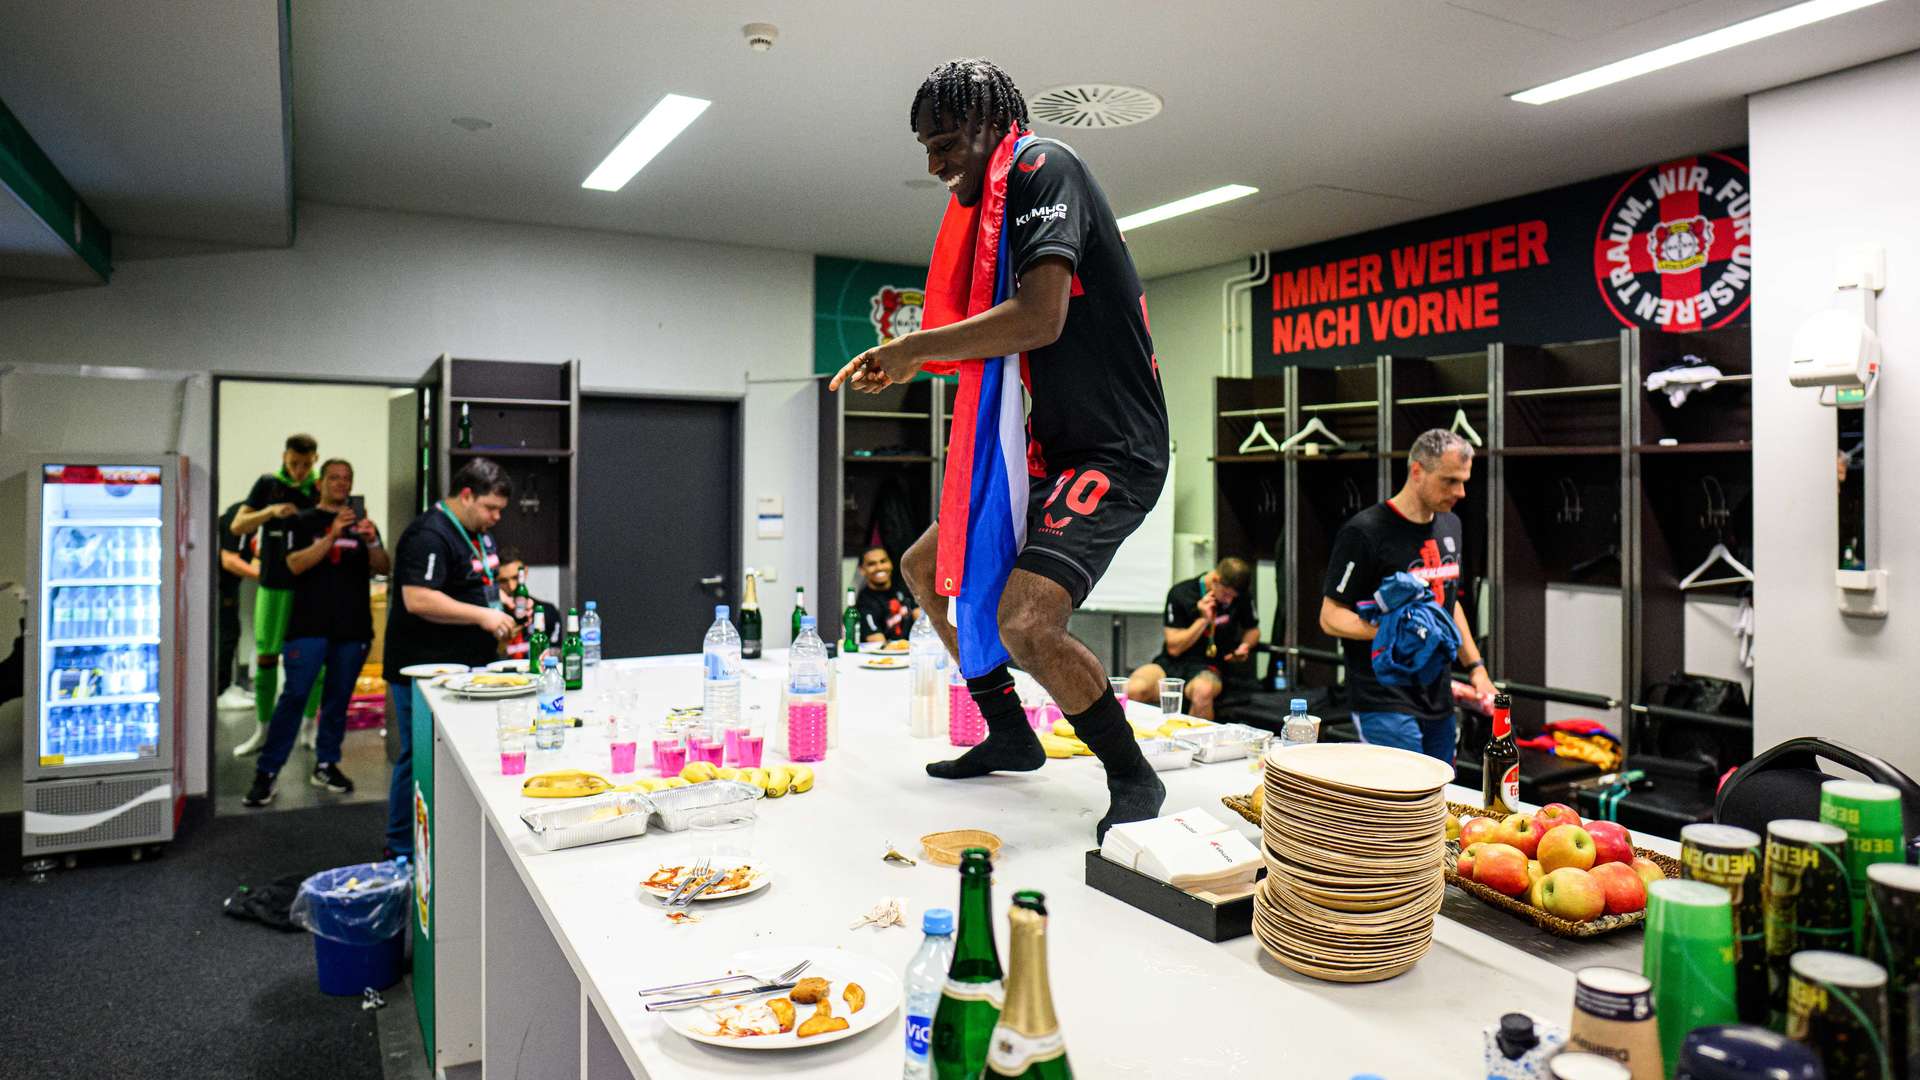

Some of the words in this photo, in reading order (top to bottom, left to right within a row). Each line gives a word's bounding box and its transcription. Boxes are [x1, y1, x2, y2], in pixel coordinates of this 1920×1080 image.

[1649, 166, 1713, 200] WIR.
[1272, 254, 1384, 311] IMMER
[1391, 219, 1550, 290] WEITER
[1606, 196, 1654, 305] TRAUM.
[1634, 244, 1751, 325] UNSEREN
[1272, 304, 1361, 355] NACH
[1367, 281, 1500, 342] VORNE
